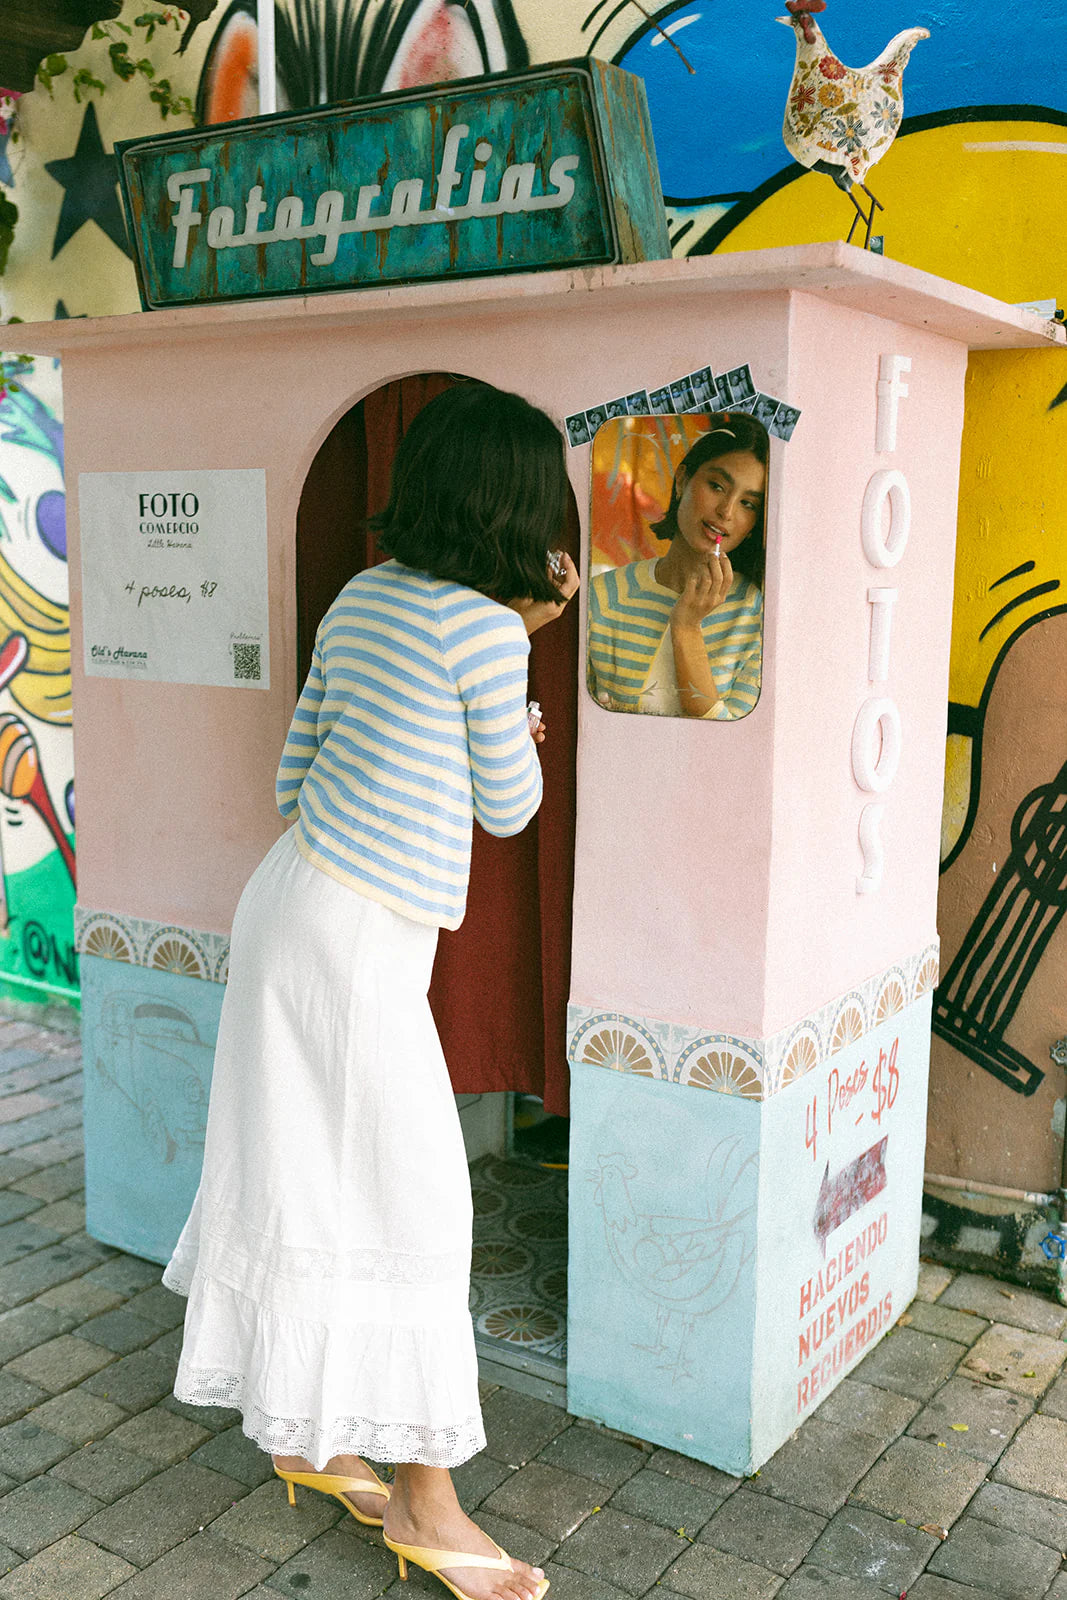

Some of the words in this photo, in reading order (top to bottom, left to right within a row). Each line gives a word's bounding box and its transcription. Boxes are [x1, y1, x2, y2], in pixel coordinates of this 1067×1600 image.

[166, 123, 580, 269] Fotografias
[139, 492, 200, 518] FOTO
[139, 521, 200, 535] COMERCIO
[125, 580, 136, 595] 4
[200, 580, 218, 598] $8
[112, 646, 148, 660] Havana
[22, 919, 81, 985] @N
[805, 1094, 818, 1162] 4
[871, 1036, 899, 1126] $8
[799, 1212, 888, 1320] HACIENDO
[798, 1271, 870, 1368] NUEVOS
